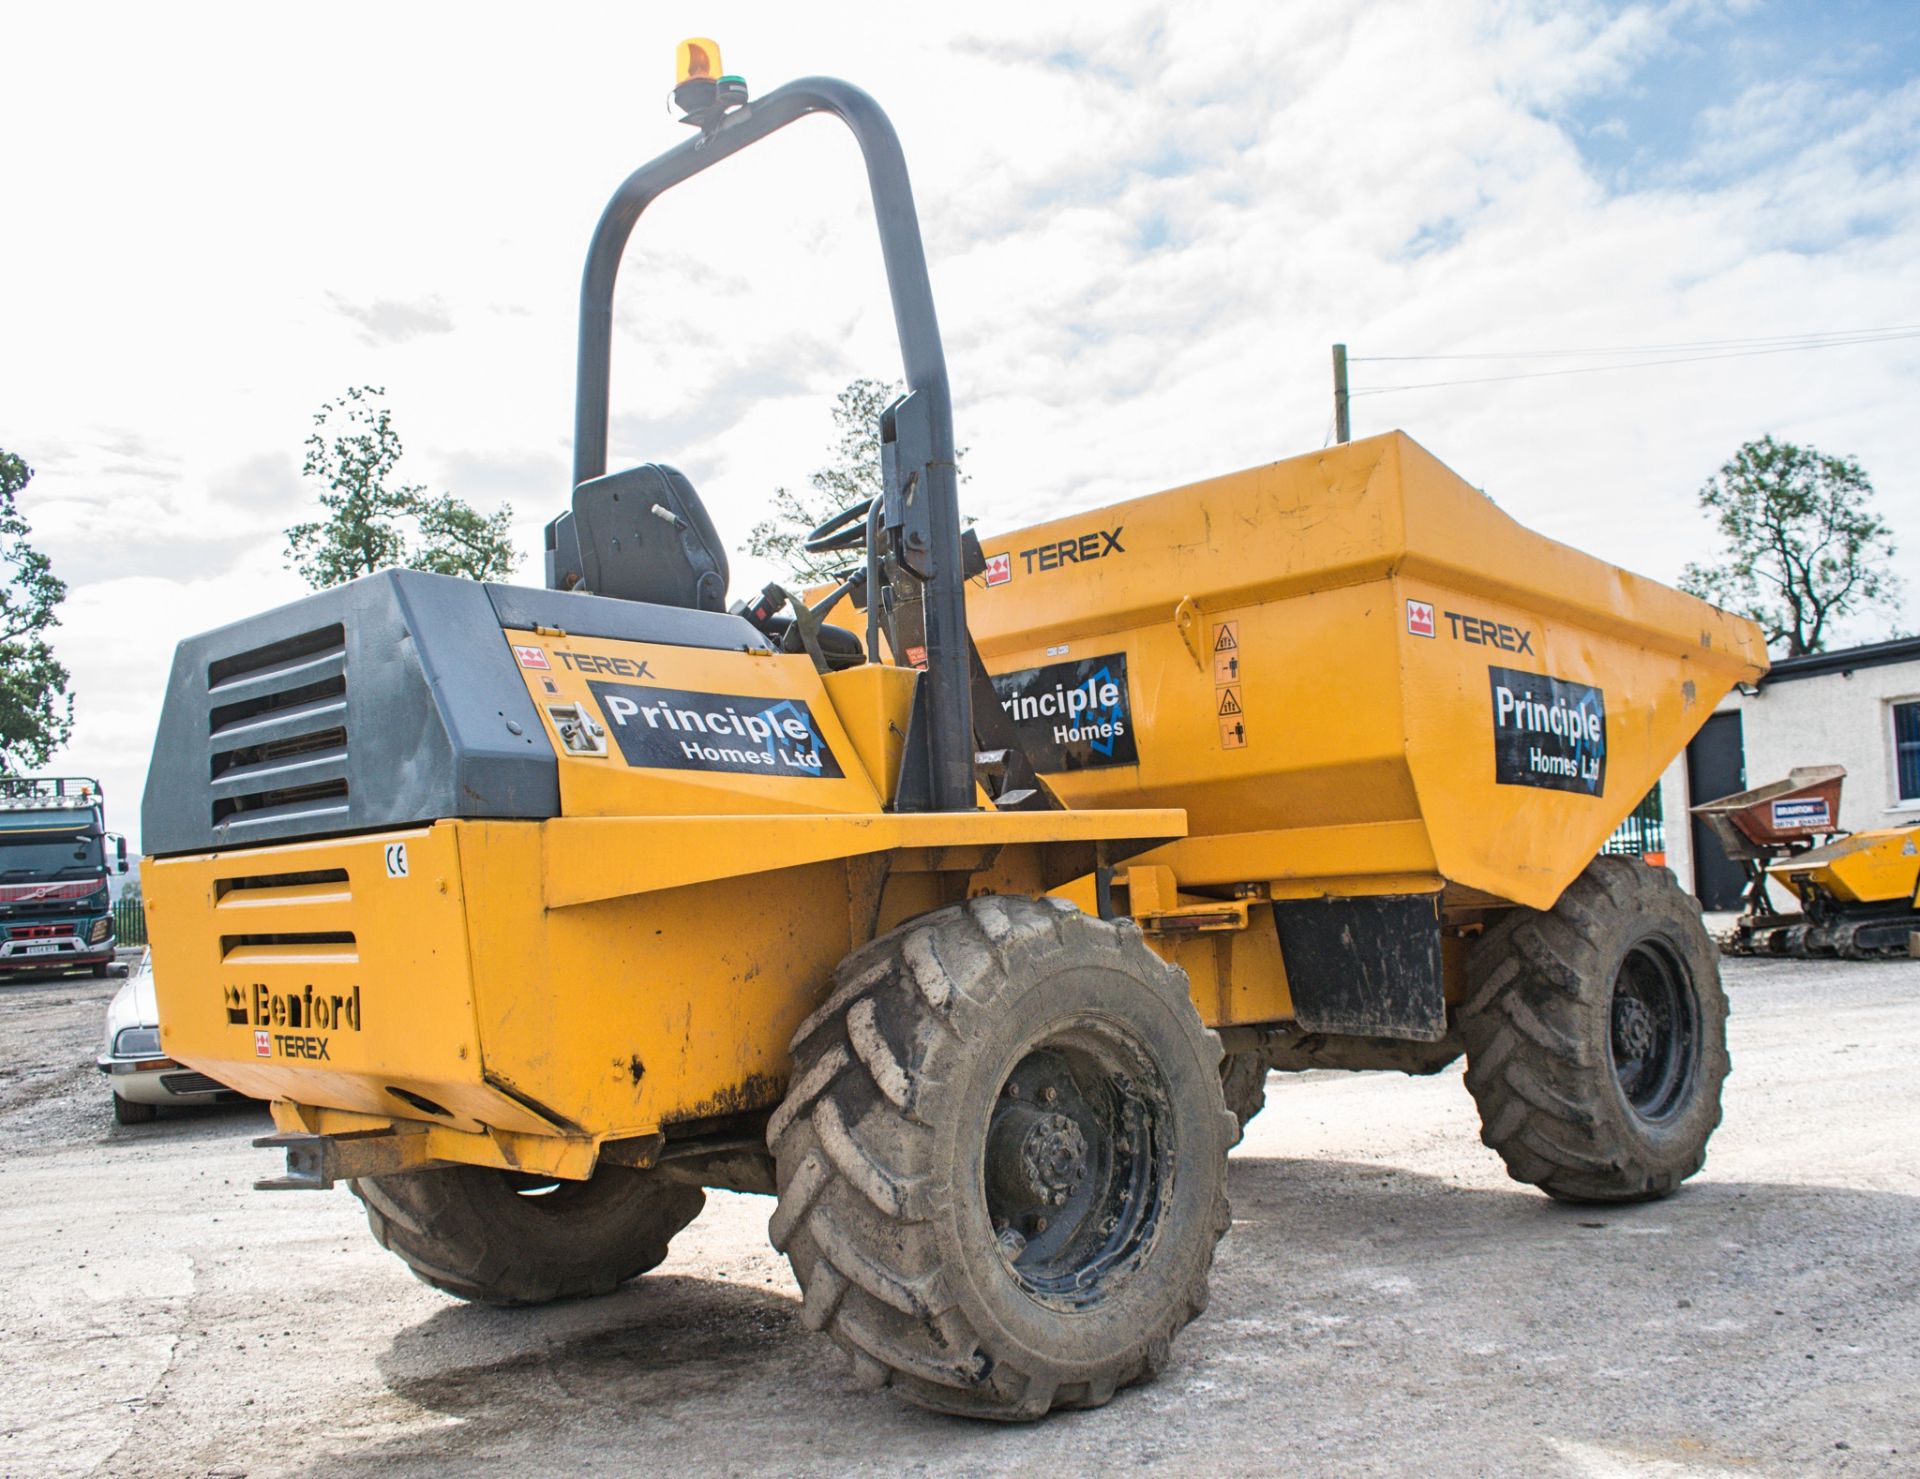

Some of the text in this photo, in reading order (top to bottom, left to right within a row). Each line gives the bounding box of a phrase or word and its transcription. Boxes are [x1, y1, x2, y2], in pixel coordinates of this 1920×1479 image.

[1020, 526, 1126, 575] TEREX
[1444, 611, 1535, 656] TEREX
[554, 651, 656, 679] TEREX
[604, 695, 809, 743] Principle
[1001, 678, 1119, 721] rinciple
[1496, 686, 1600, 747] Principle
[680, 740, 822, 768] Homes Ltd
[1053, 721, 1124, 744] Homes
[1530, 747, 1578, 777] Homes
[253, 983, 361, 1031] Benford
[274, 1034, 331, 1061] TEREX
